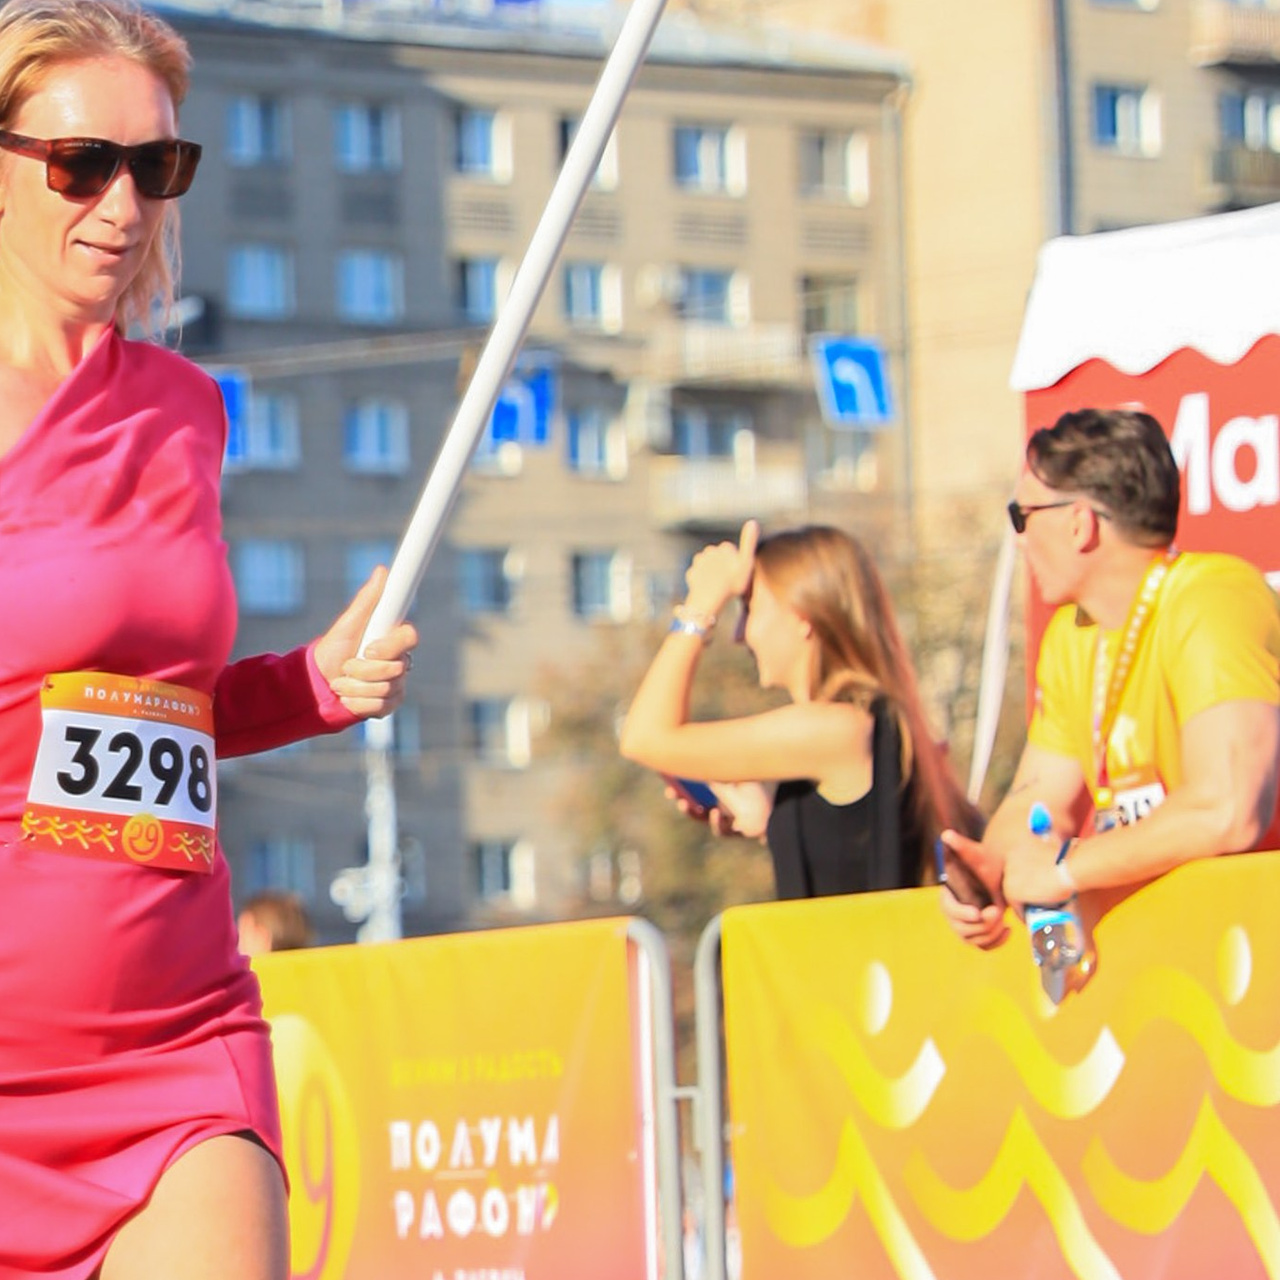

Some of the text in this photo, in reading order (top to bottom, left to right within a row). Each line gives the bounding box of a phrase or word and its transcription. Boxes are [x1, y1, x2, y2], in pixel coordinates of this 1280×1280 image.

[85, 685, 200, 716] ПОЛУМАРАФОН
[57, 726, 212, 813] 3298
[388, 1114, 560, 1171] ПОЛУМА
